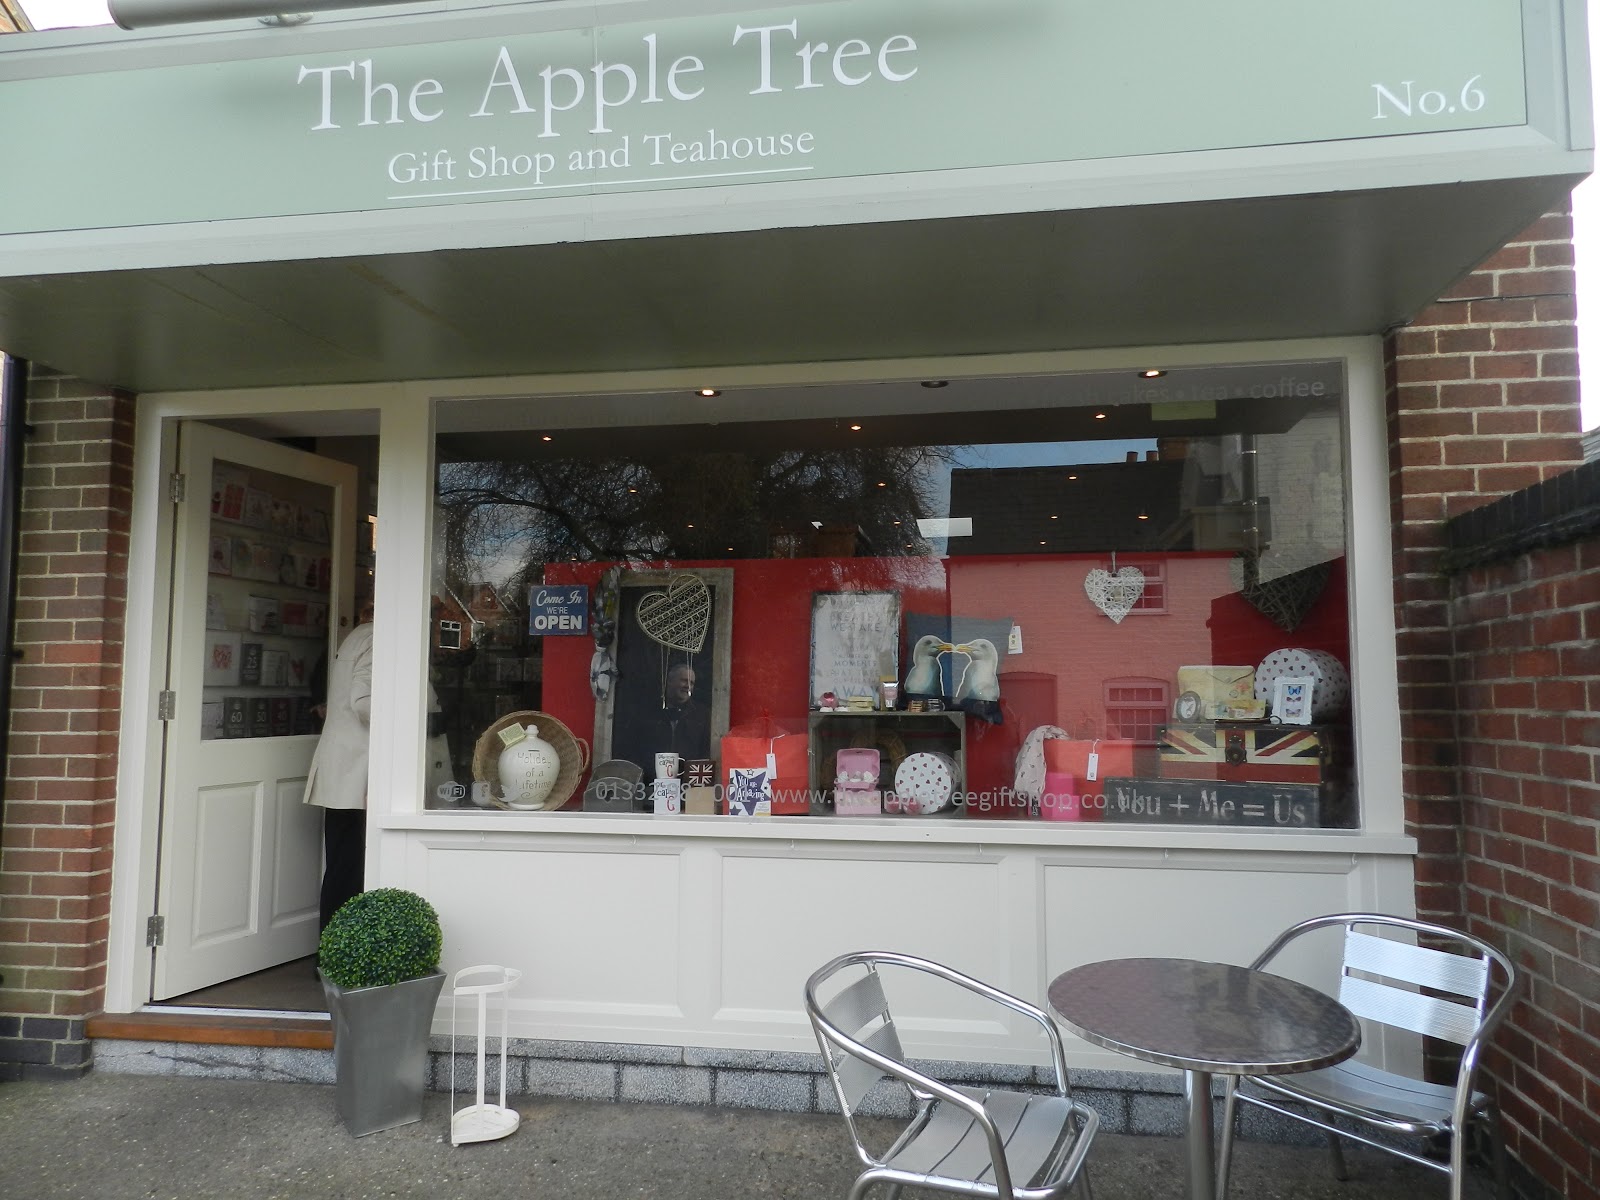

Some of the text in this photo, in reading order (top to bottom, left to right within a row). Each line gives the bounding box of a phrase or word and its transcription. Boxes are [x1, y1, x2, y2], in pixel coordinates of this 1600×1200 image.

[297, 19, 918, 139] The Apple Tree
[1371, 74, 1485, 120] No.6
[388, 129, 815, 186] Gift Shop and Teahouse
[1252, 377, 1326, 400] coffee
[536, 590, 583, 607] Come In
[546, 606, 569, 614] WE'RE
[534, 615, 583, 630] OPEN
[231, 711, 243, 723] 60
[525, 768, 535, 778] of
[1199, 789, 1236, 819] Me
[1272, 794, 1306, 824] Us
